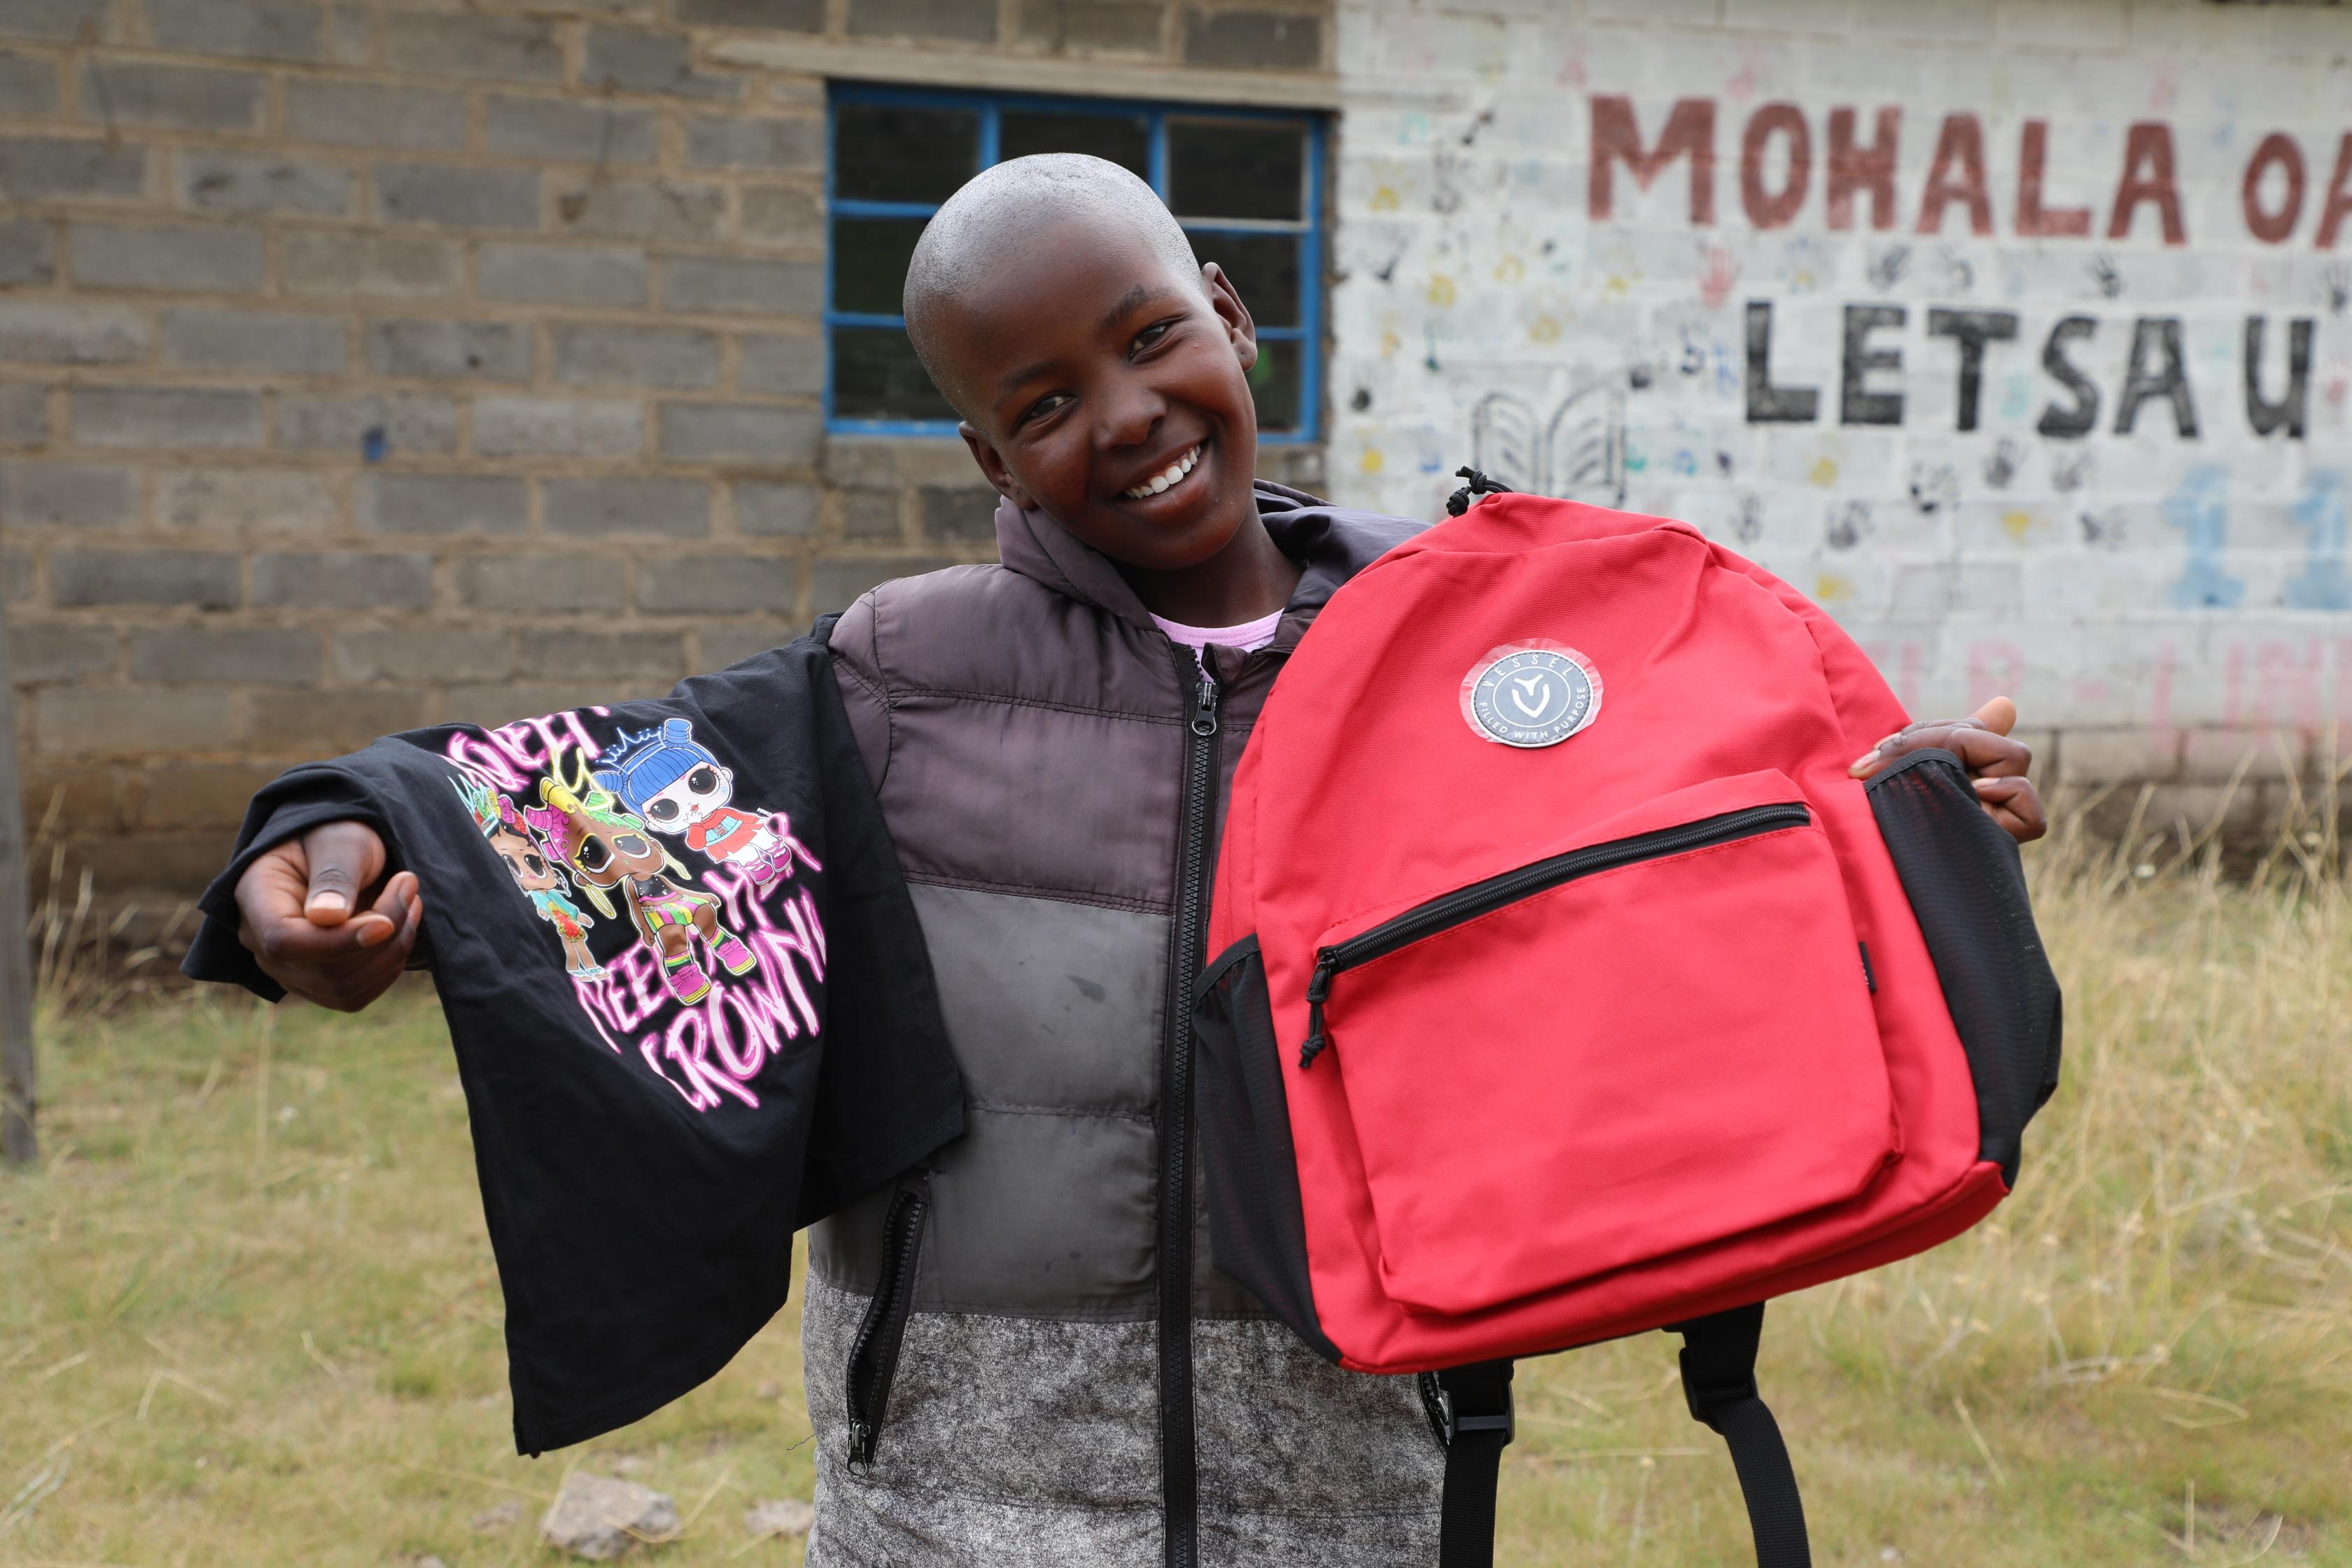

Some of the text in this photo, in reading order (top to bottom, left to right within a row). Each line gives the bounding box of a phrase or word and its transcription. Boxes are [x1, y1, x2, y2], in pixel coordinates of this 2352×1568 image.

[1588, 93, 2188, 247] MOHALA
[1482, 654, 1574, 688] VESSEL
[1479, 687, 1586, 740] FILLED WITH PURPOSE
